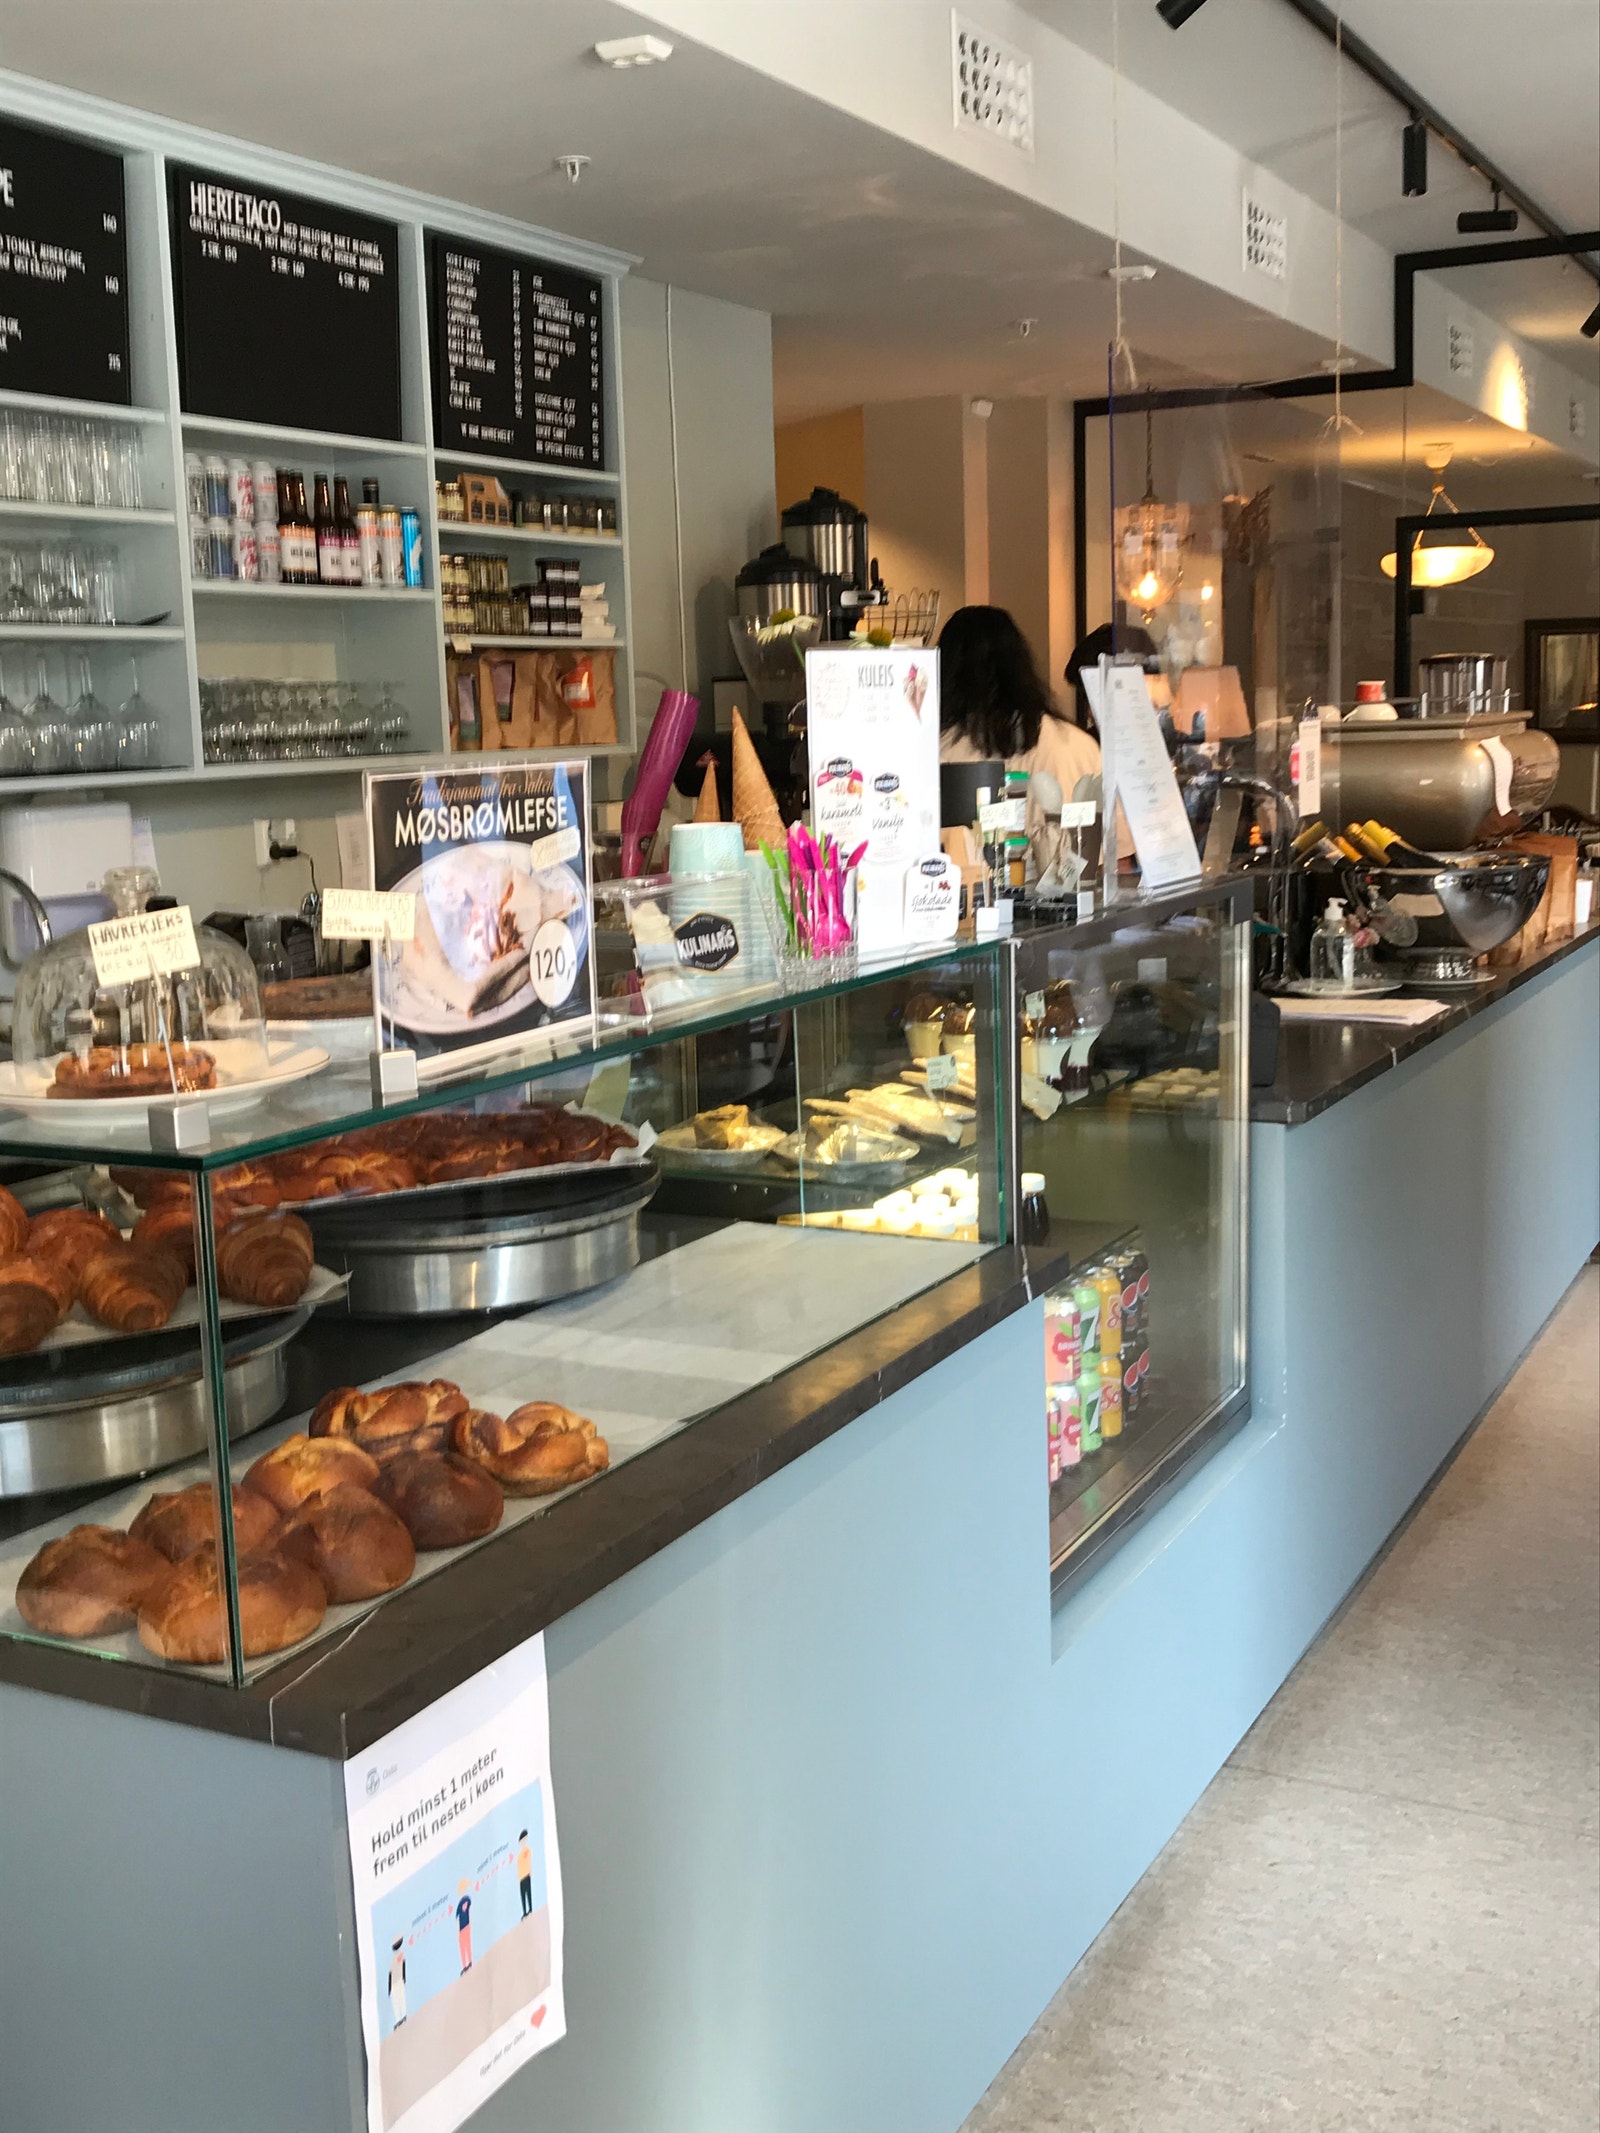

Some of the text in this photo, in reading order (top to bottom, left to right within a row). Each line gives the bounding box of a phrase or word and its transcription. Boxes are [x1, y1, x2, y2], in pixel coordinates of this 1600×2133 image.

[103, 212, 117, 234] 160
[105, 275, 119, 295] 160
[858, 663, 894, 689] KULEIS
[394, 796, 568, 848] MØSBRØMLEFSE
[90, 911, 184, 947] HAVREKJEKS
[371, 1748, 498, 1855] Hold minst 1 meter
[373, 1766, 504, 1879] frem til neste i køen
